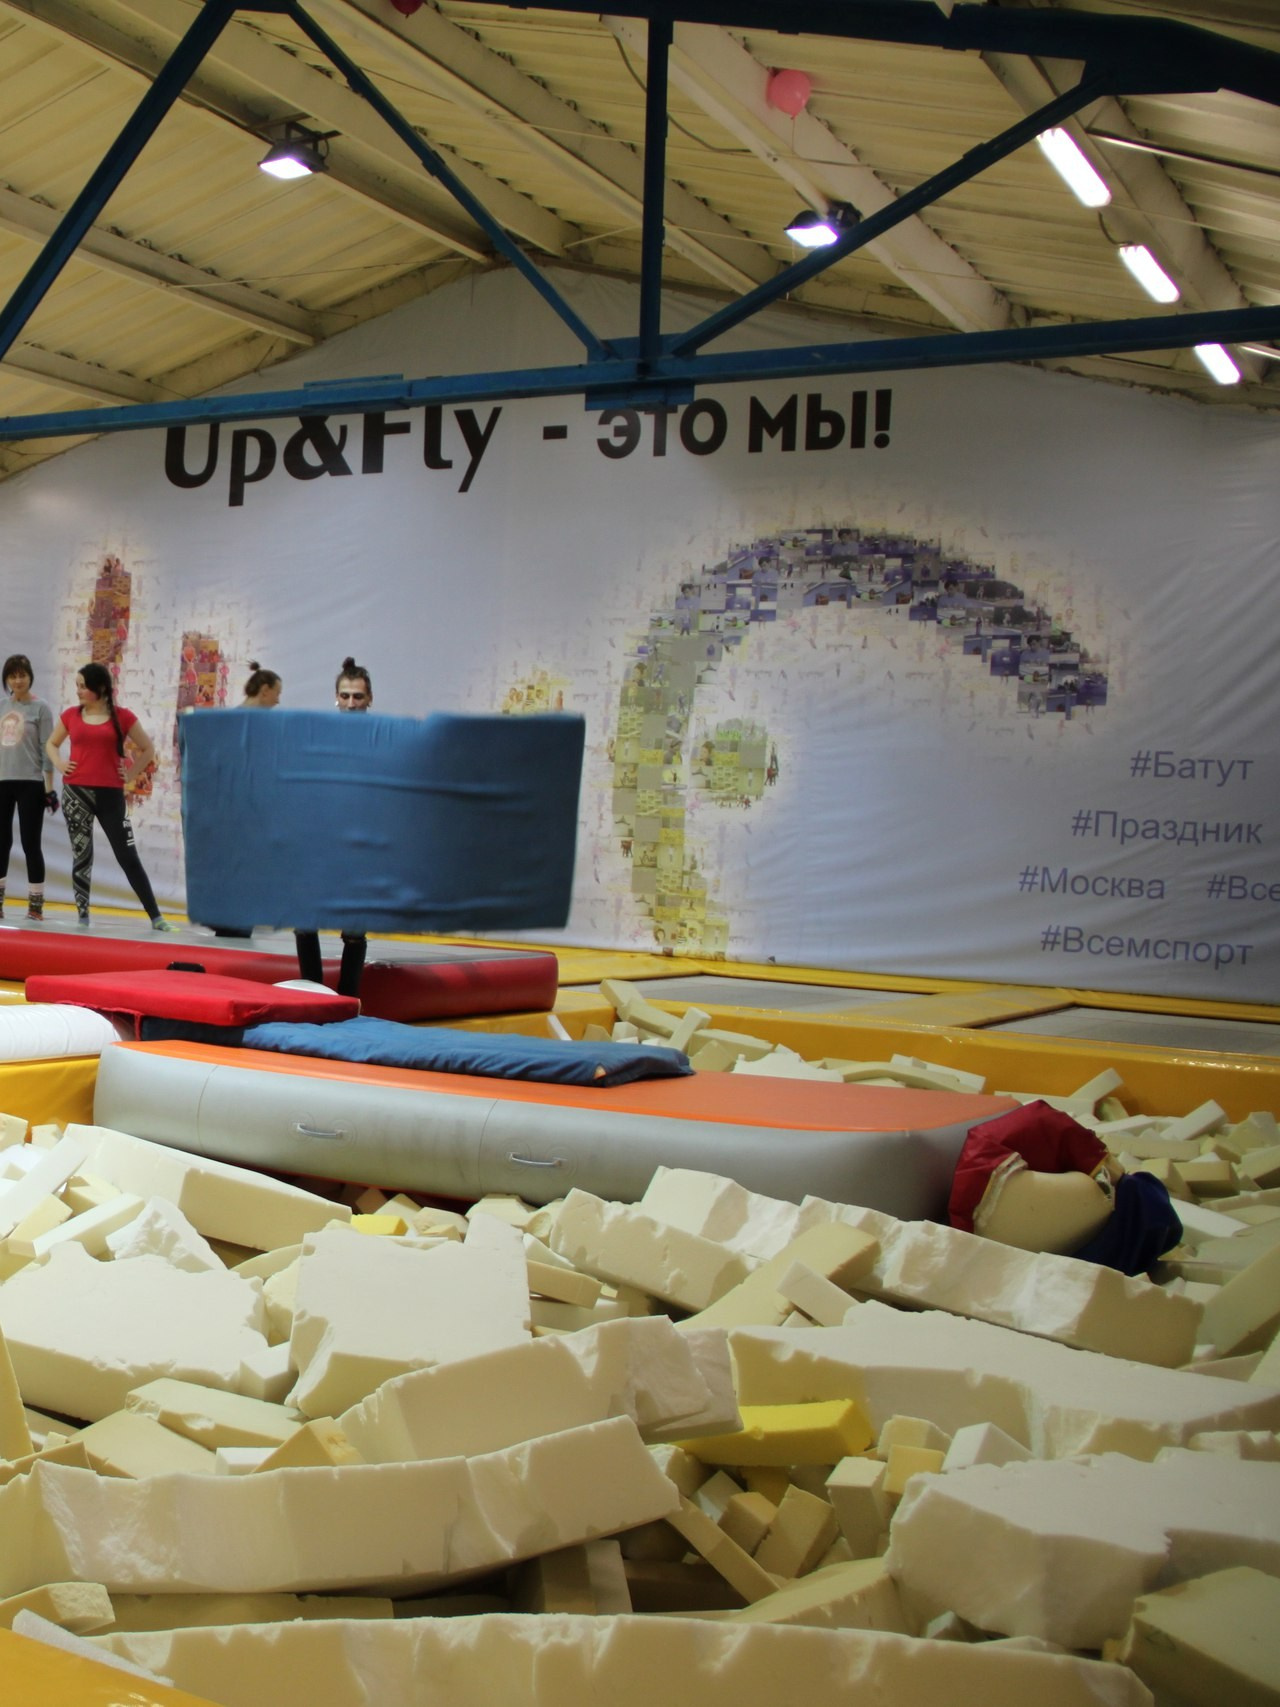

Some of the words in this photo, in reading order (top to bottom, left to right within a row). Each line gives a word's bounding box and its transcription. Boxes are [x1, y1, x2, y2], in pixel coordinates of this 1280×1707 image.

[164, 405, 503, 507] Up&Fly
[1130, 750, 1254, 787] #Батут
[1071, 809, 1263, 847] #Праздник
[1019, 865, 1166, 900] #Москва
[1041, 924, 1254, 971] #Всемспорт
